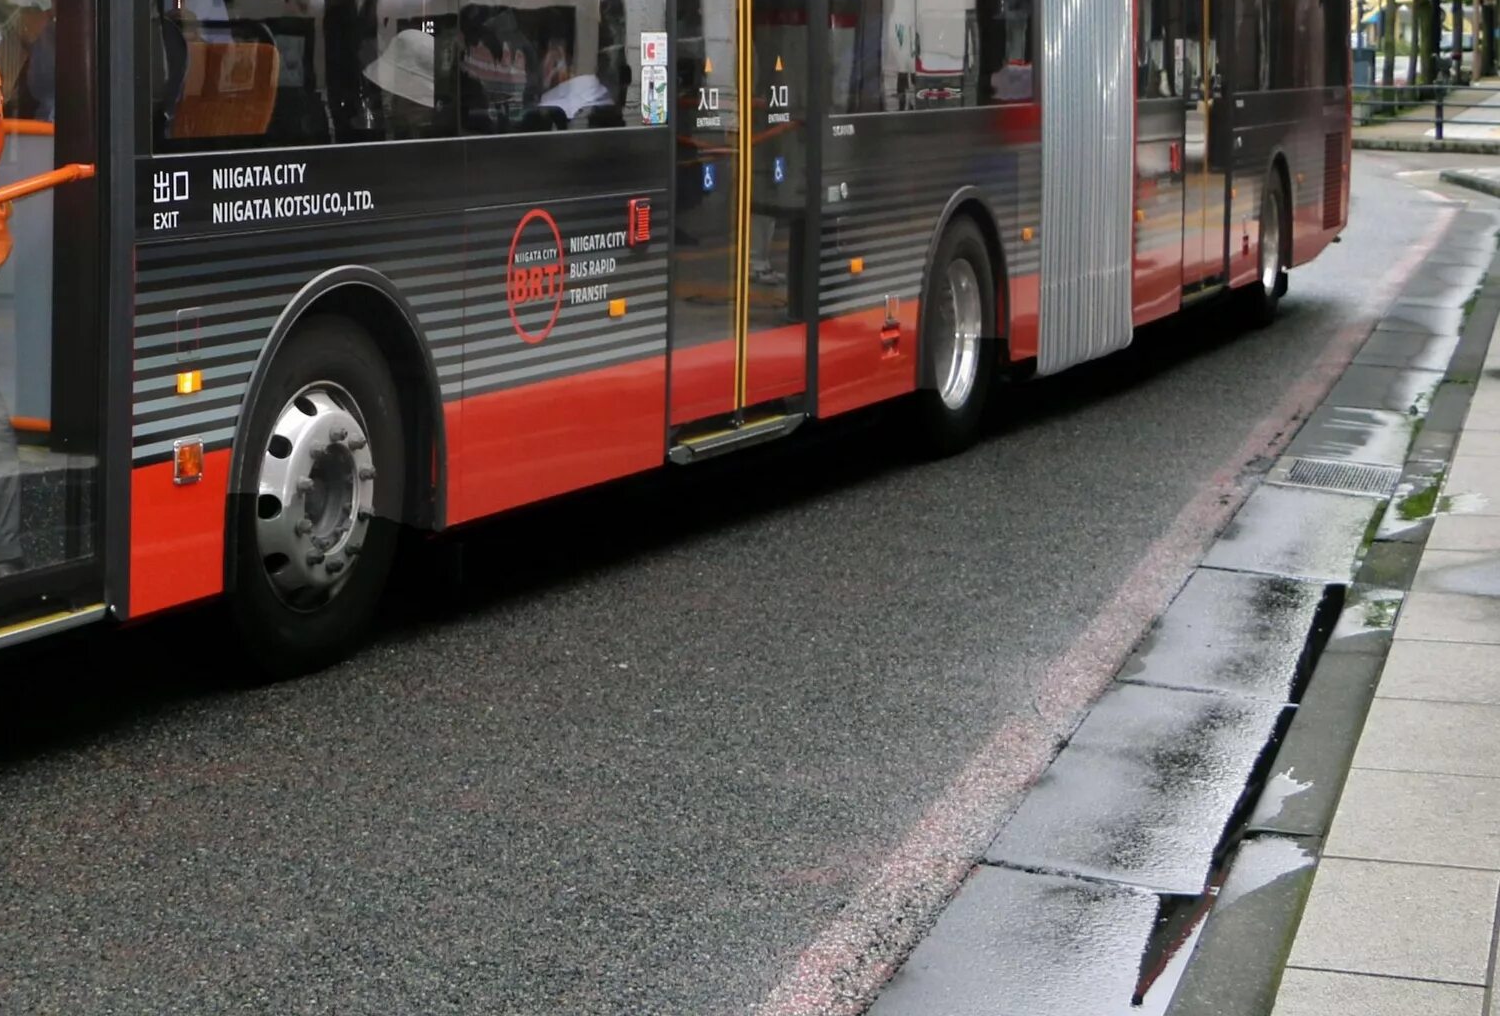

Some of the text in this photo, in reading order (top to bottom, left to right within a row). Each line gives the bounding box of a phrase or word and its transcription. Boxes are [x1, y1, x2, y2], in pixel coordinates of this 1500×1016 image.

[698, 88, 719, 111] 入口
[769, 85, 788, 107] 入口
[696, 116, 721, 128] ENTRANCE
[768, 113, 790, 124] ENTRANCE
[153, 171, 189, 203] 出口
[212, 163, 307, 190] NIIGATA CITY
[212, 199, 272, 224] NIIGATA
[275, 194, 320, 218] KOTSU
[153, 211, 179, 230] EXIT
[570, 231, 627, 253] NIIGATA CITY
[514, 248, 558, 263] NIIGATA CITY
[570, 258, 616, 279] BUS RAPID
[514, 264, 559, 304] BRT
[570, 284, 608, 304] TRANSIT
